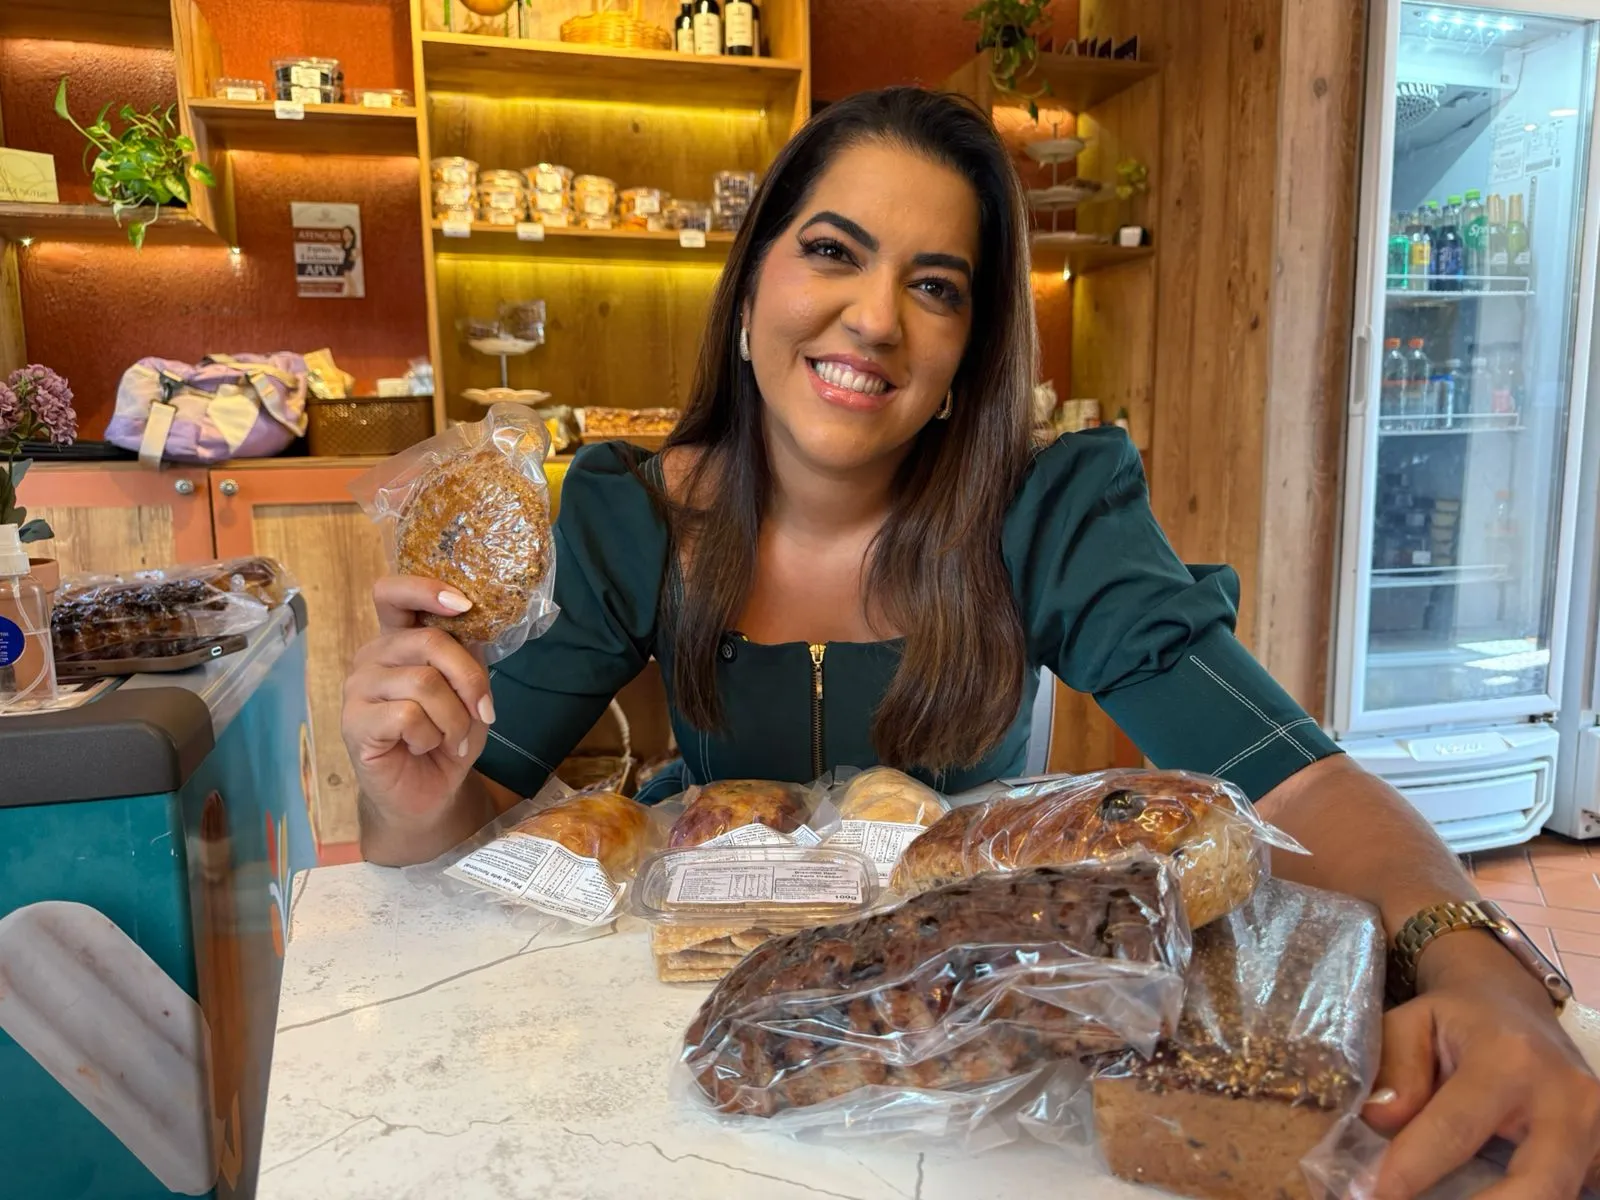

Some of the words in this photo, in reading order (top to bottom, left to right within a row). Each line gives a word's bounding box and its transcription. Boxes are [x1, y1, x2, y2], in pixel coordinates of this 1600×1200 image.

[463, 863, 490, 875] funcional
[489, 872, 502, 880] leite
[510, 881, 523, 889] Pão
